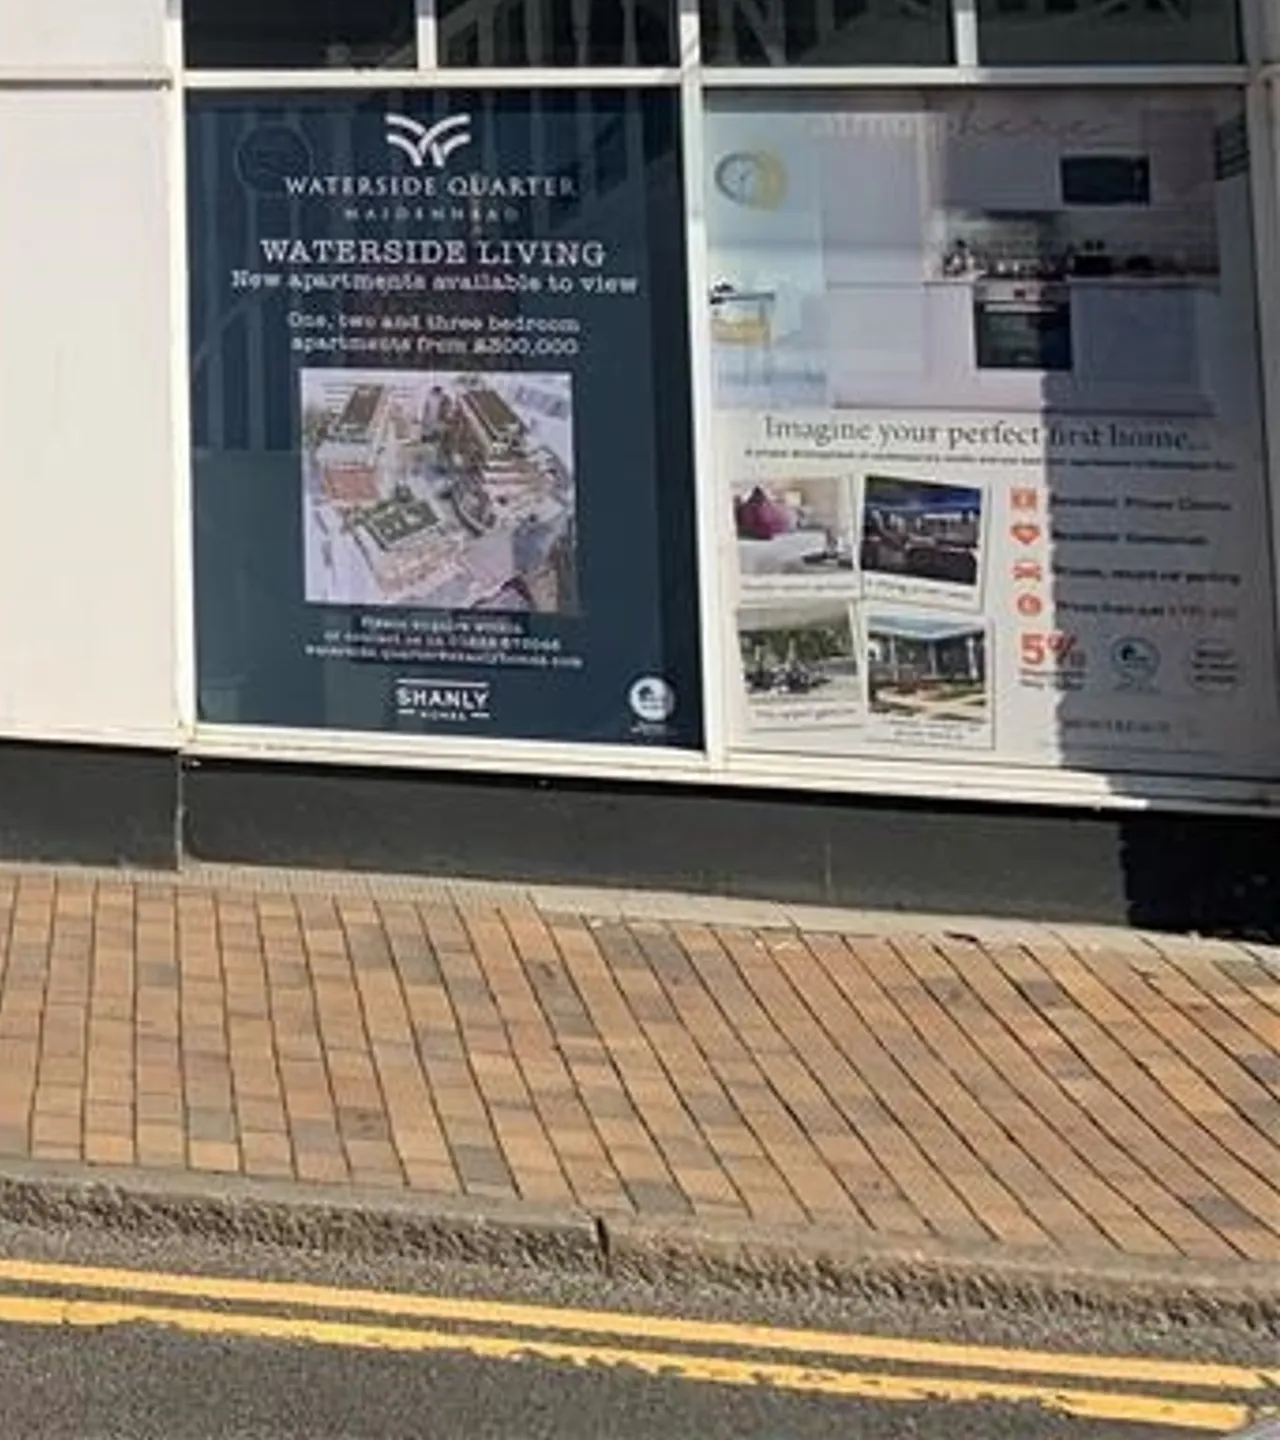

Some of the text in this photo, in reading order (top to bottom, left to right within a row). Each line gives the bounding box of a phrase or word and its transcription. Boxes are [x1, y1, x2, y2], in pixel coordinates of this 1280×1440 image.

[285, 175, 578, 198] WATERSIDE QUARTER
[260, 238, 607, 268] WATERSIDE LIVING
[231, 269, 638, 294] New apartments available to view
[763, 415, 872, 447] Imagine
[879, 421, 943, 448] your
[949, 419, 1040, 451] perfect
[1048, 421, 1105, 448] first
[396, 687, 489, 710] SHANLY
